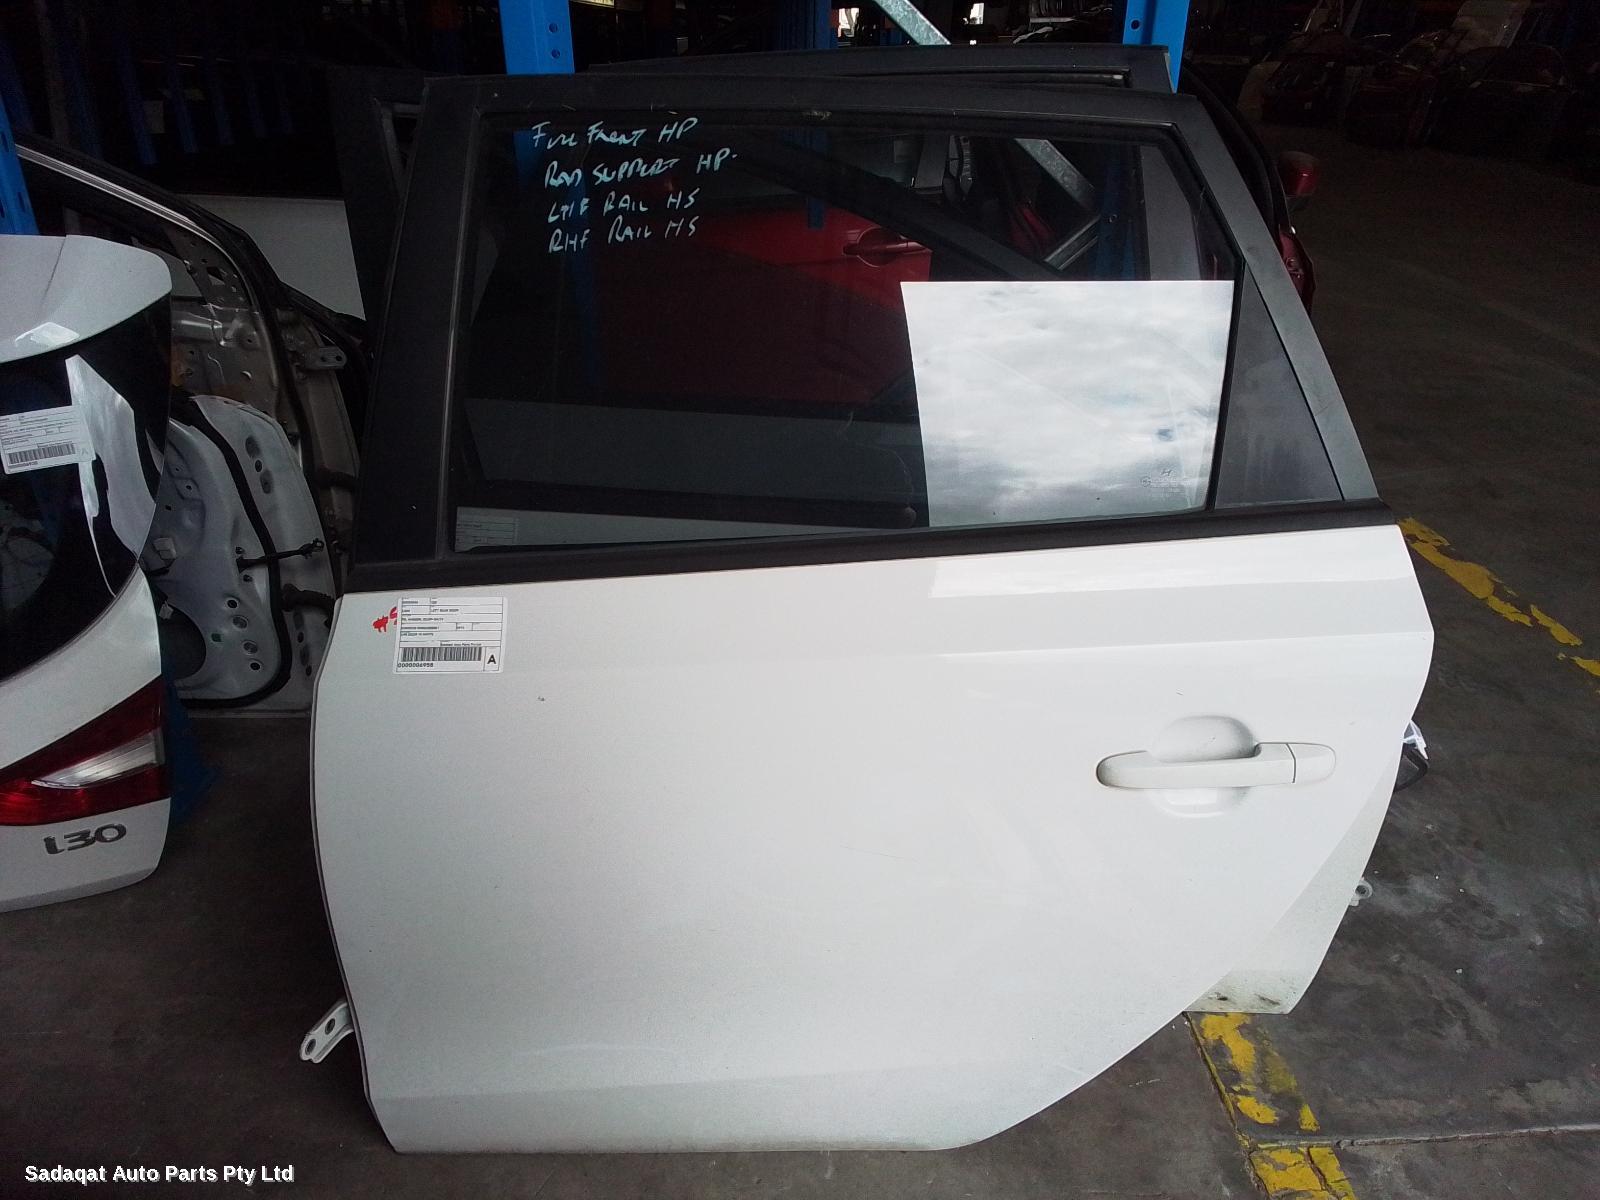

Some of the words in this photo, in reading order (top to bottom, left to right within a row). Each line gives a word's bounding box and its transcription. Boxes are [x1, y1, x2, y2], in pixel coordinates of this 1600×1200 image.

[658, 117, 699, 143] HP
[602, 190, 649, 216] RAIL
[548, 228, 591, 254] RHF
[607, 215, 653, 244] RAIL
[487, 654, 497, 664] A
